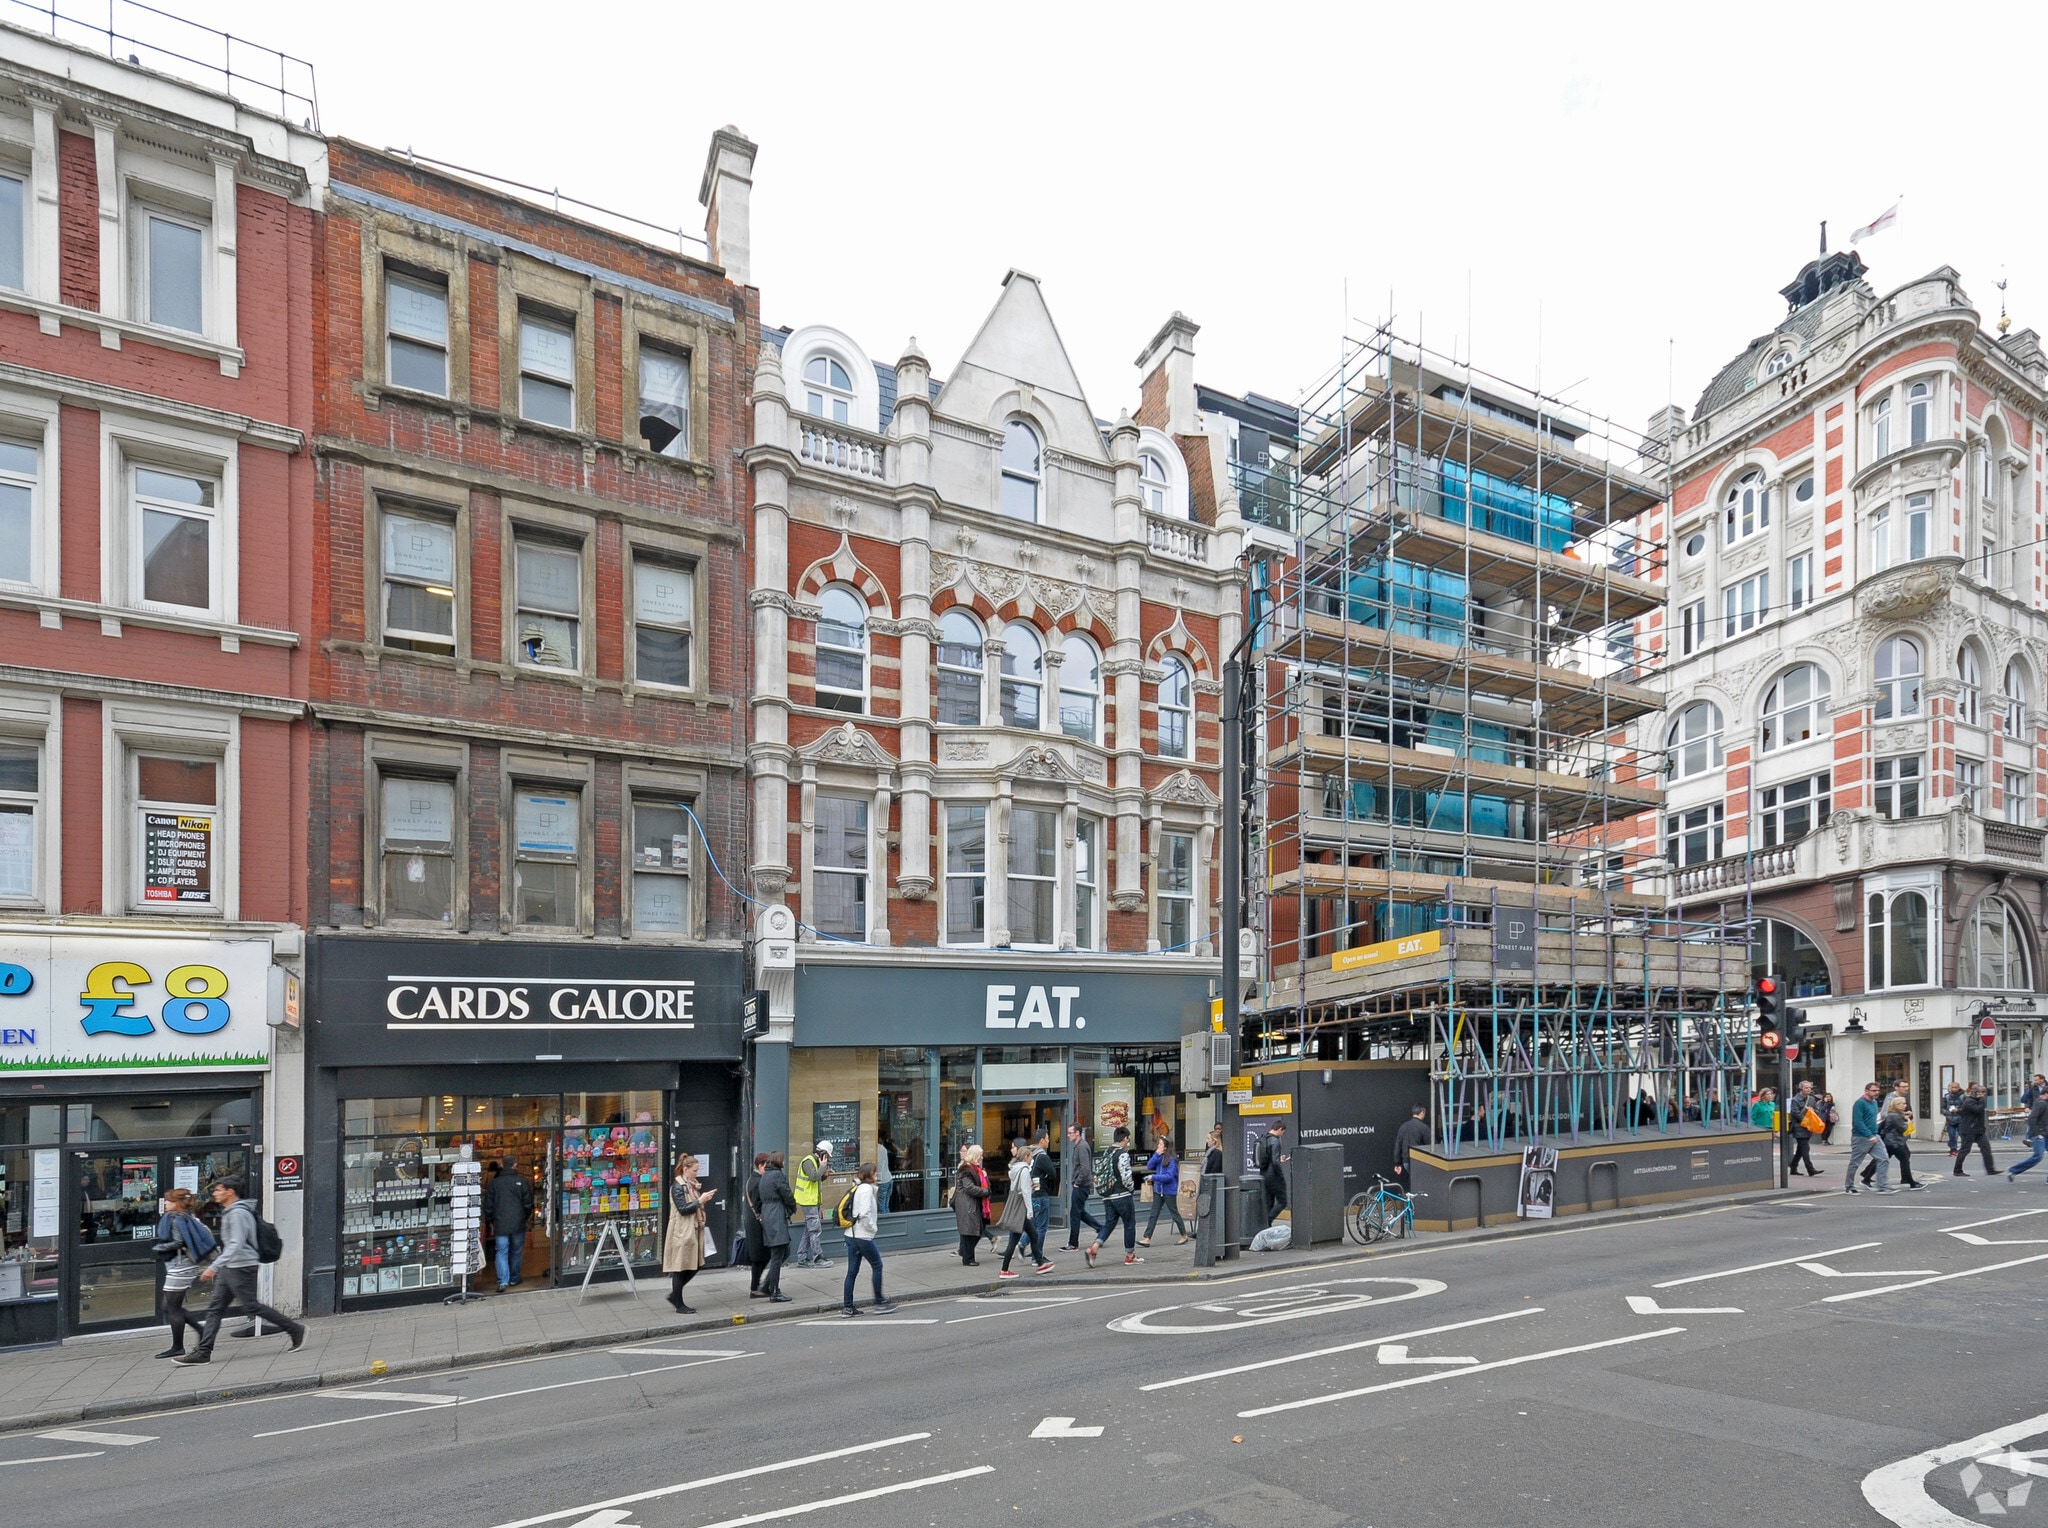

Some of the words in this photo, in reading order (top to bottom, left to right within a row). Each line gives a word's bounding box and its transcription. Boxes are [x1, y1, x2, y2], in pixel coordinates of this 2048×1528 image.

[147, 815, 177, 826] Canon
[179, 819, 210, 830] Nikon
[157, 830, 176, 838] HEAD
[177, 831, 205, 840] PHONES
[157, 839, 206, 850] MICROPHONES
[167, 849, 206, 859] EQUIPMENT
[157, 858, 175, 866] DSLR
[177, 859, 207, 868] CAMERAS
[157, 867, 196, 877] AMPLIFIERS
[157, 876, 167, 884] CD
[168, 877, 198, 886] PLAYERS
[146, 889, 173, 898] TOSHIBA
[178, 891, 210, 900] BOSE
[1398, 939, 1423, 955] EAT.
[80, 961, 231, 1036] £8
[386, 986, 530, 1020] CARDS
[549, 988, 694, 1020] GALORE
[985, 984, 1087, 1030] EAT.
[0, 1028, 35, 1046] EN
[1271, 1099, 1288, 1109] EAT.
